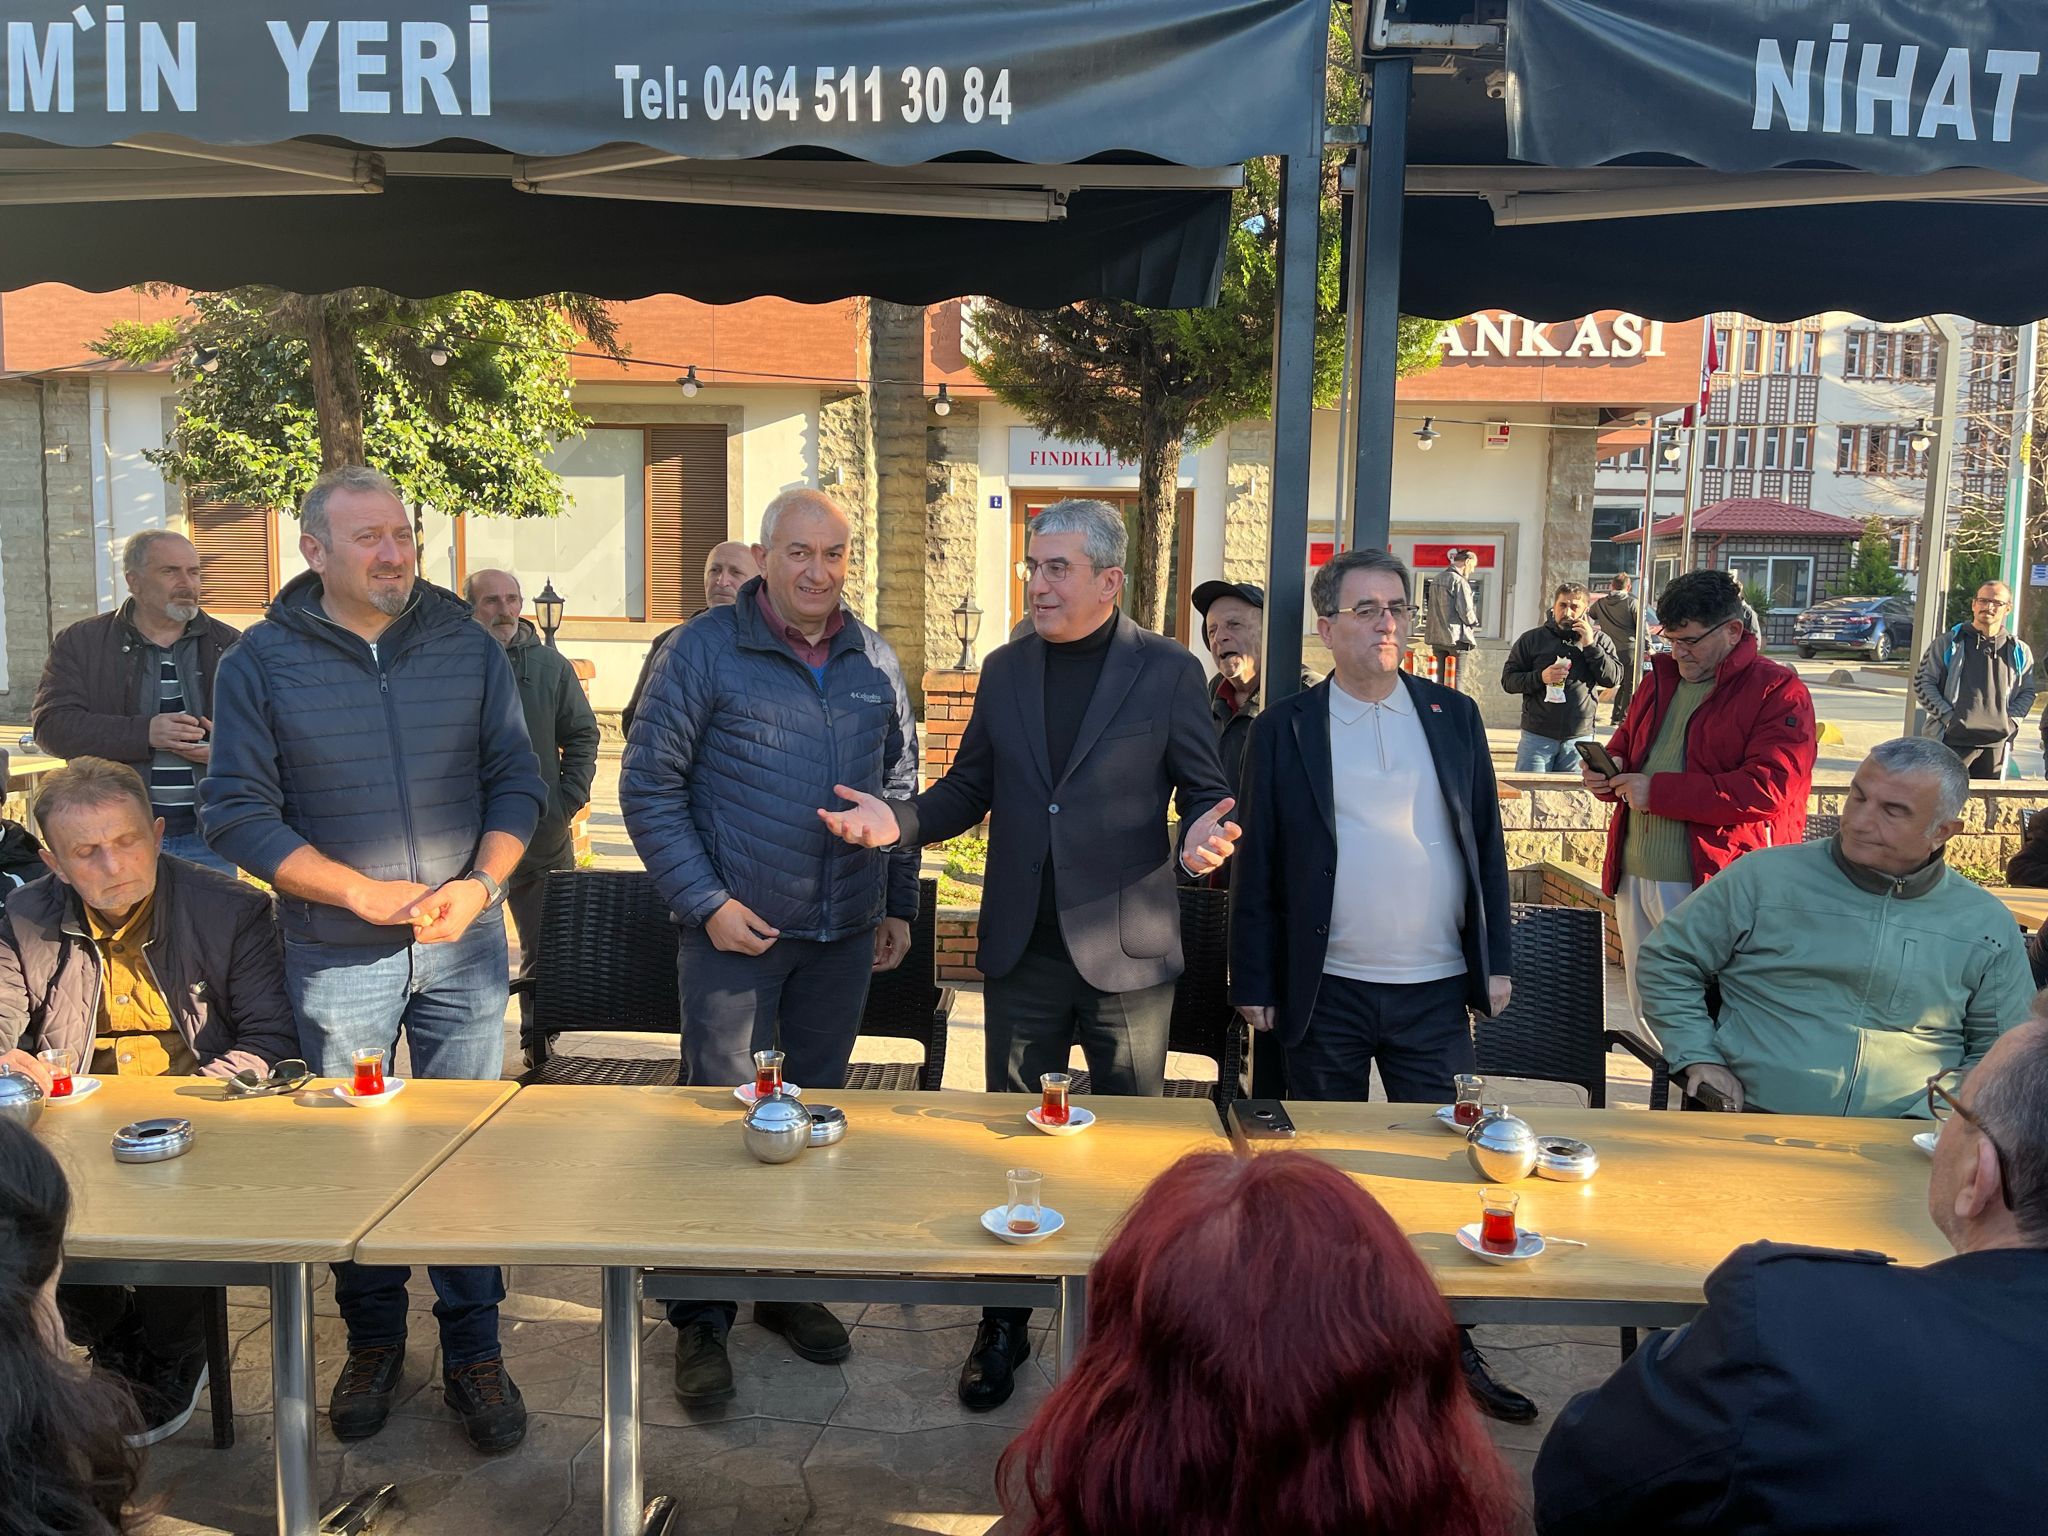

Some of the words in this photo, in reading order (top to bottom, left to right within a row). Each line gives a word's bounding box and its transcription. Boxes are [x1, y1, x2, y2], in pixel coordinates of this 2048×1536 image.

[265, 4, 492, 116] YERİ
[614, 64, 689, 120] Tel:
[703, 64, 800, 122] 0464
[813, 65, 882, 123] 511
[900, 66, 948, 124] 30
[962, 66, 1012, 125] 84
[1751, 23, 2041, 143] NİHAT
